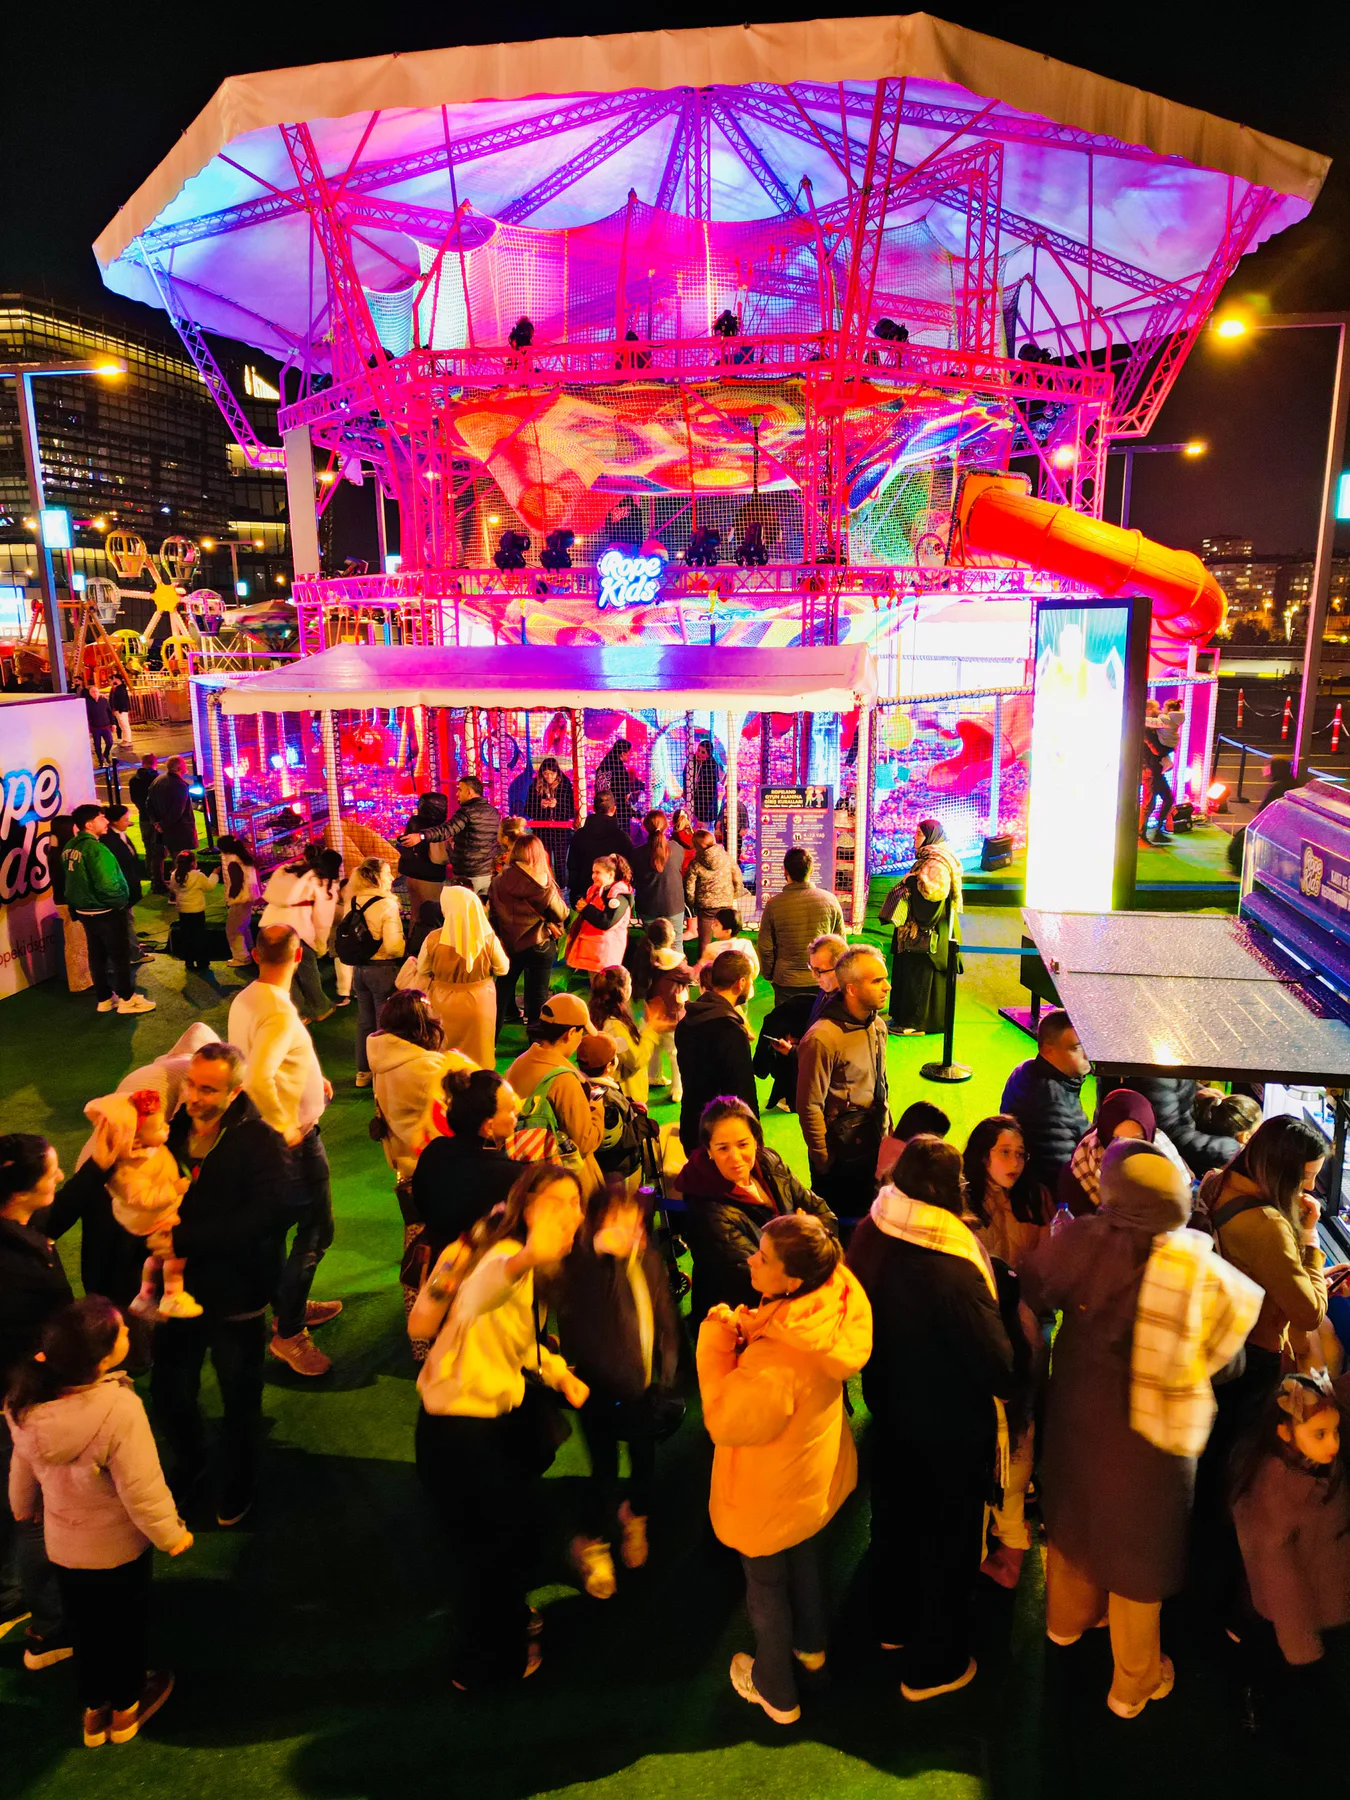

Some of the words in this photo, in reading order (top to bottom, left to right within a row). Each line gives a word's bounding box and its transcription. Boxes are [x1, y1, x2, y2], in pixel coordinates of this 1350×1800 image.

[600, 550, 661, 582] Rope
[598, 574, 657, 607] Kids
[0, 769, 60, 840] pe
